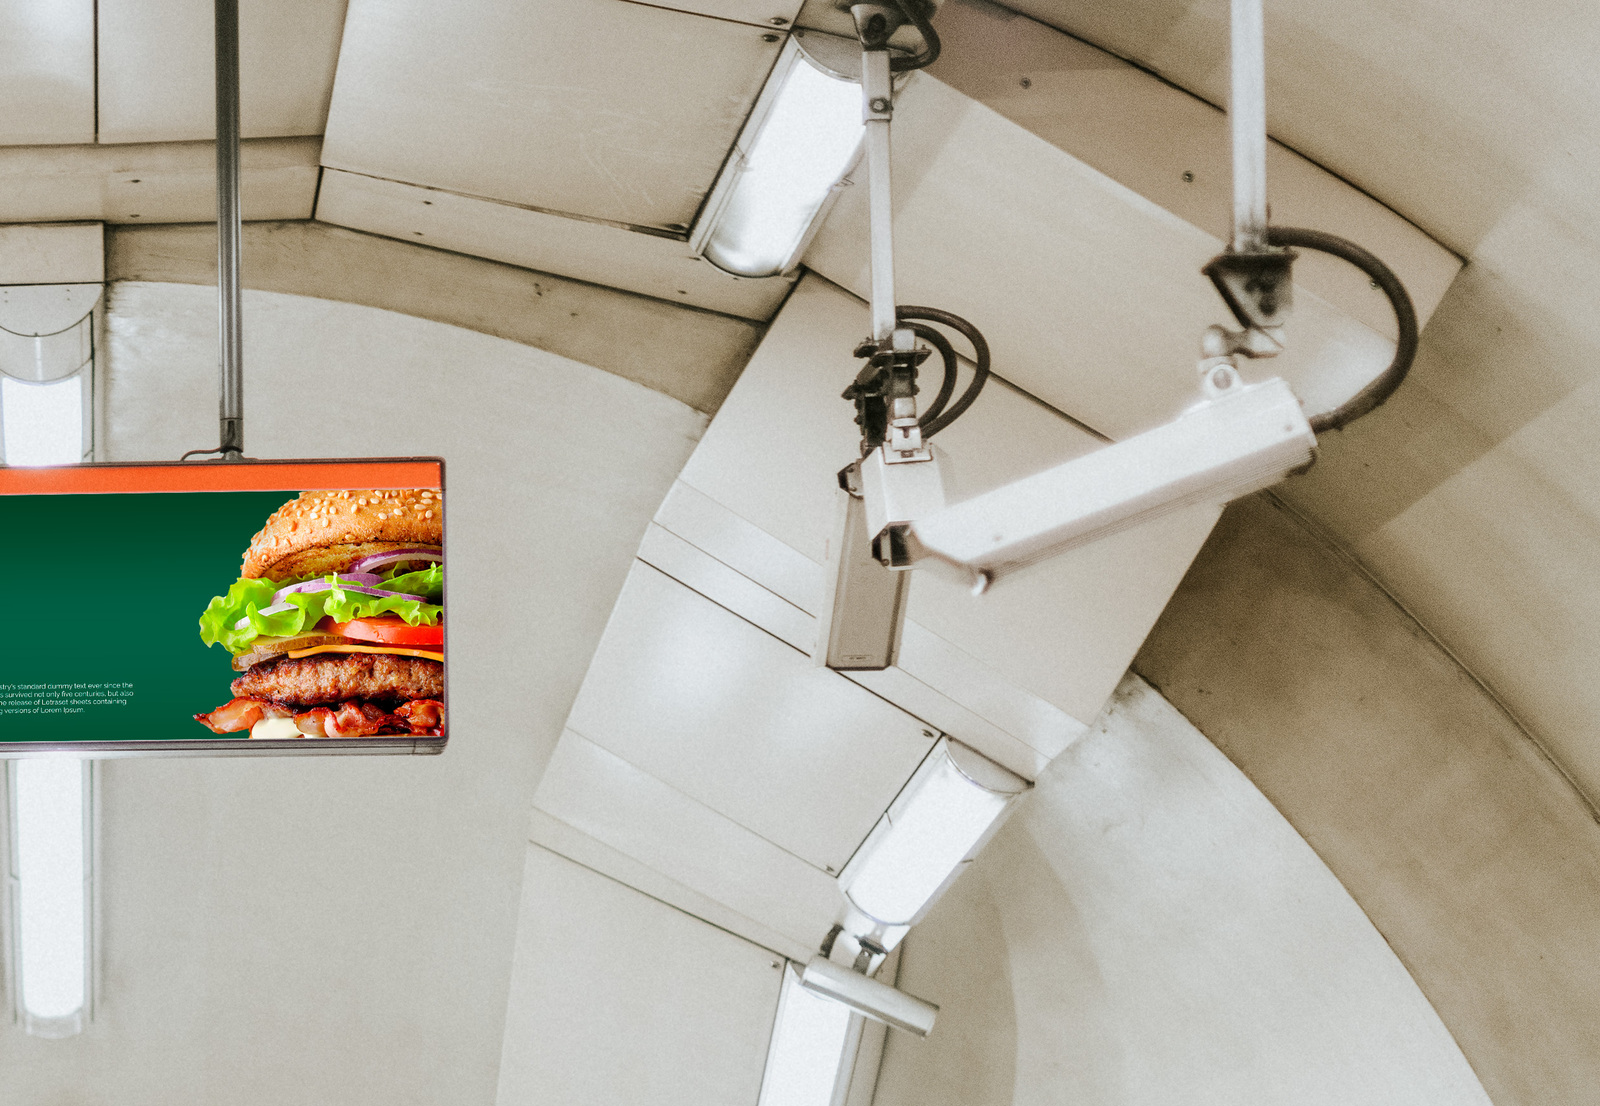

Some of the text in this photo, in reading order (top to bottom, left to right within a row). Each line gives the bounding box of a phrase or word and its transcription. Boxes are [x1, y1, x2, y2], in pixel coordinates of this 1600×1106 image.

[47, 683, 72, 691] dummy
[46, 691, 60, 699] only
[63, 707, 85, 715] Ipsum.
